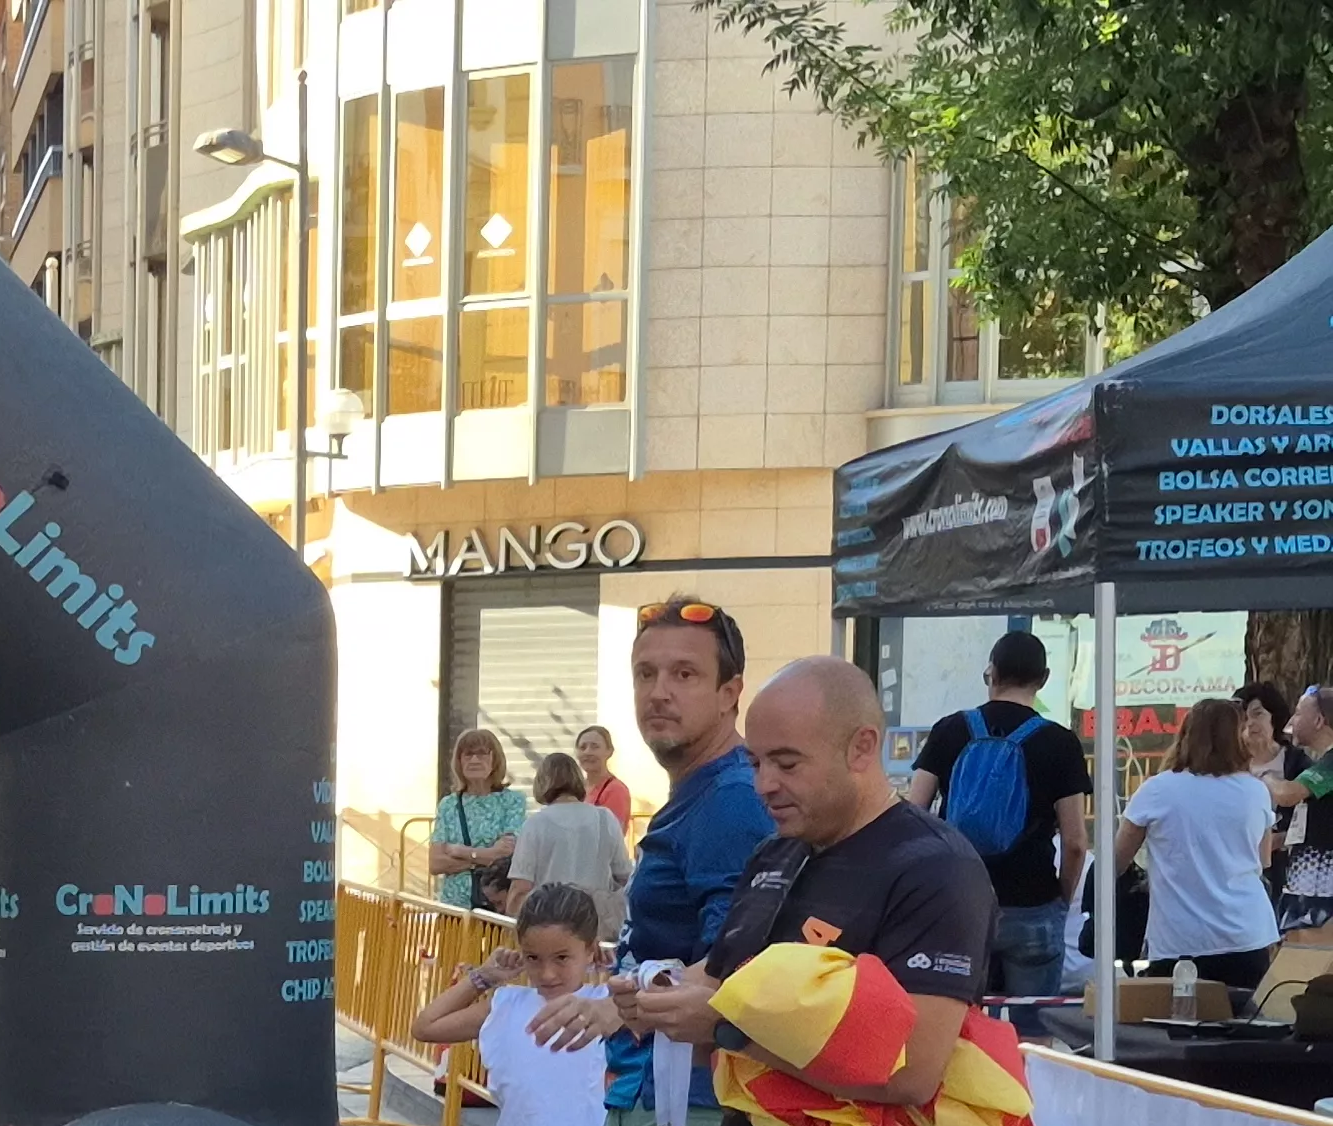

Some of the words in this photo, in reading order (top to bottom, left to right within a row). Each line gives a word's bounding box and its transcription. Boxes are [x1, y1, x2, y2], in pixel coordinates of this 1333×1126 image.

[1210, 404, 1333, 425] DORSALES
[1171, 436, 1267, 457] VALLAS
[1271, 435, 1289, 454] Y
[1295, 433, 1333, 454] AR
[1159, 469, 1239, 491] BOLSA
[1244, 465, 1333, 487] CORRE
[1154, 502, 1265, 525] SPEAKER
[1269, 500, 1288, 521] Y
[403, 520, 646, 578] MANGO
[1136, 536, 1246, 561] TROFEOS
[1251, 536, 1269, 555] Y
[1274, 534, 1333, 555] MED
[281, 978, 321, 1002] CHIP
